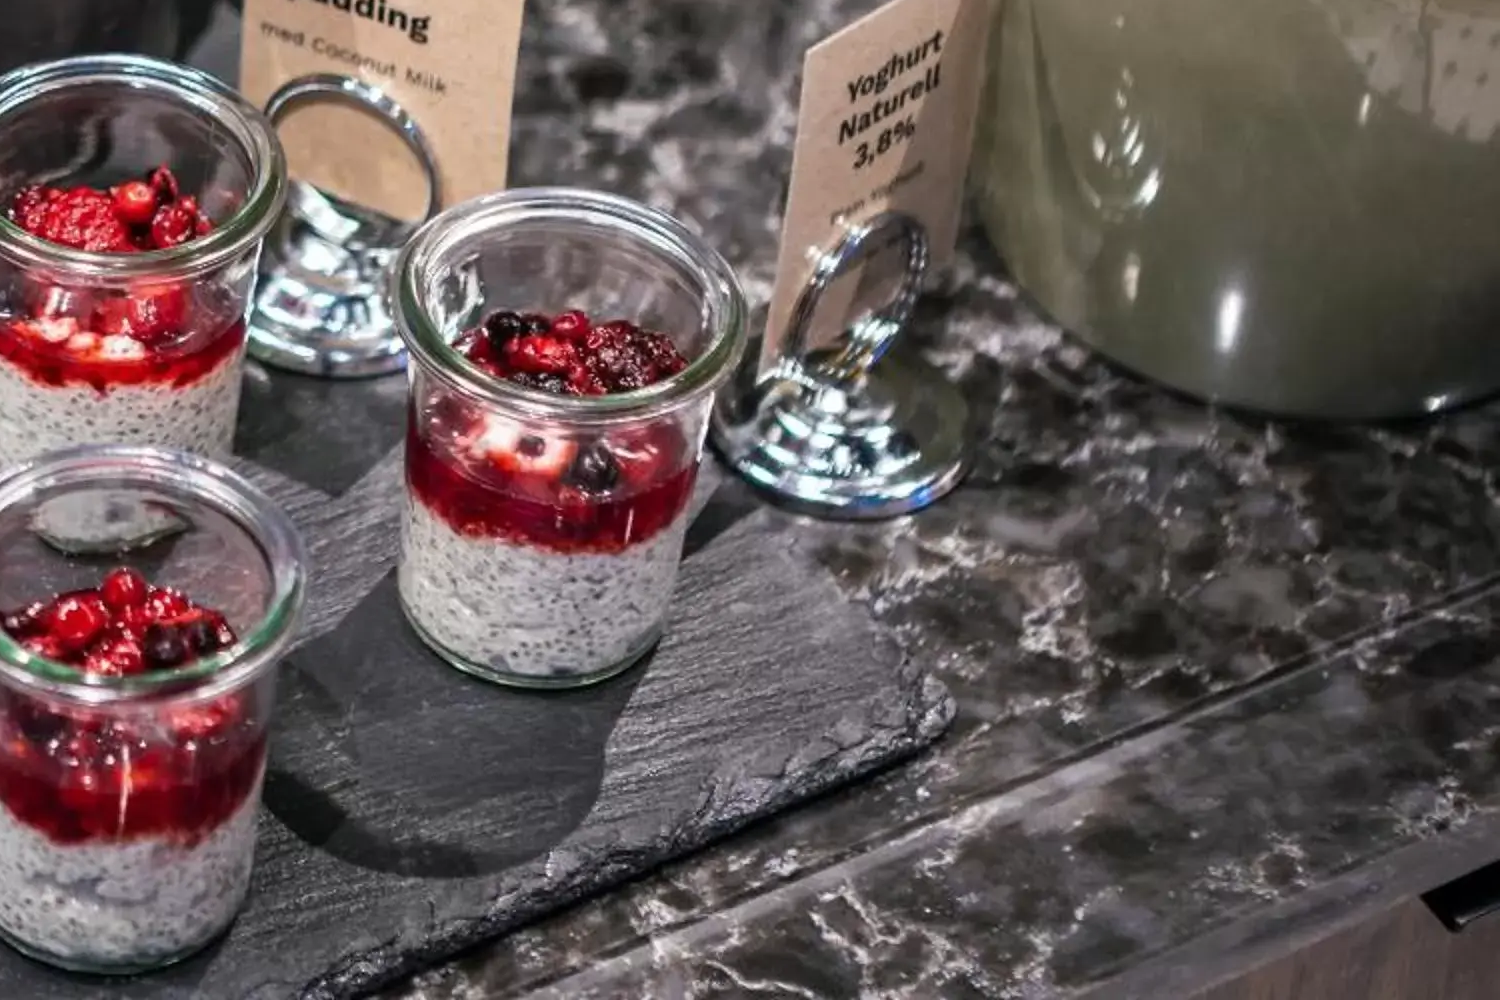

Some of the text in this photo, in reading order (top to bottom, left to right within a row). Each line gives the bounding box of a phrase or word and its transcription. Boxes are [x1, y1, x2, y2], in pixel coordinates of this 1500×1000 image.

[260, 20, 448, 95] med Coconut Milk
[846, 30, 944, 104] Yoghurt
[838, 63, 941, 146] Naturell
[852, 115, 916, 171] 3,8%
